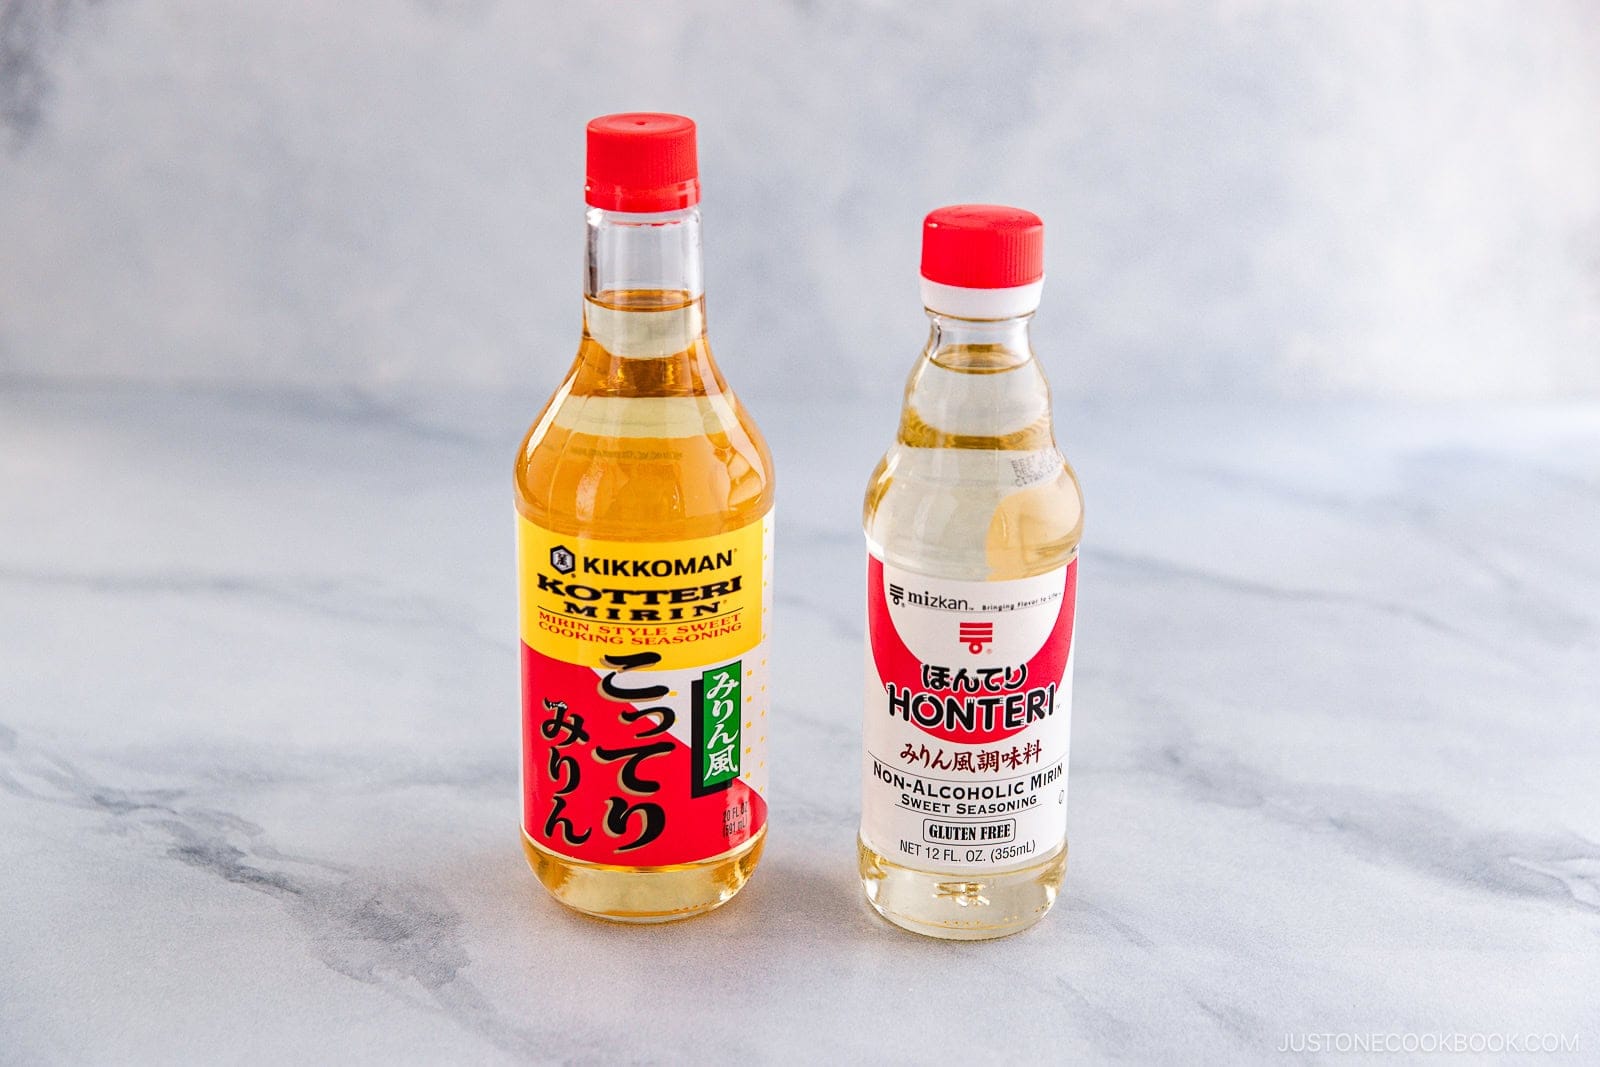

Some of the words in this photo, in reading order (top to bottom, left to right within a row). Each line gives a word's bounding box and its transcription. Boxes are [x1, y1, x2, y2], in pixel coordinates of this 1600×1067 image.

[583, 549, 732, 577] KIKKOMAN
[537, 573, 742, 605] KOTTERI
[908, 590, 969, 611] mizkan
[982, 603, 1015, 612] Bringing
[539, 610, 590, 632] MIRIN
[599, 624, 668, 637] STYLE
[677, 612, 740, 633] SWEET
[563, 601, 721, 621] MIRIN
[538, 621, 624, 645] COOKING
[631, 622, 742, 646] SEASONING
[921, 663, 1027, 692] ほんてり
[887, 682, 1055, 731] HONTERI
[703, 671, 740, 782] みりん風
[591, 651, 676, 853] こってり
[900, 739, 1042, 773] みりん風調味料
[540, 696, 592, 847] みりん
[929, 822, 976, 841] GLUTEN
[979, 823, 1011, 841] FREE
[900, 839, 921, 857] NET
[925, 847, 940, 860] 12
[943, 849, 961, 862] FL.
[966, 848, 986, 862] OZ.
[990, 839, 1036, 864] (355mL)
